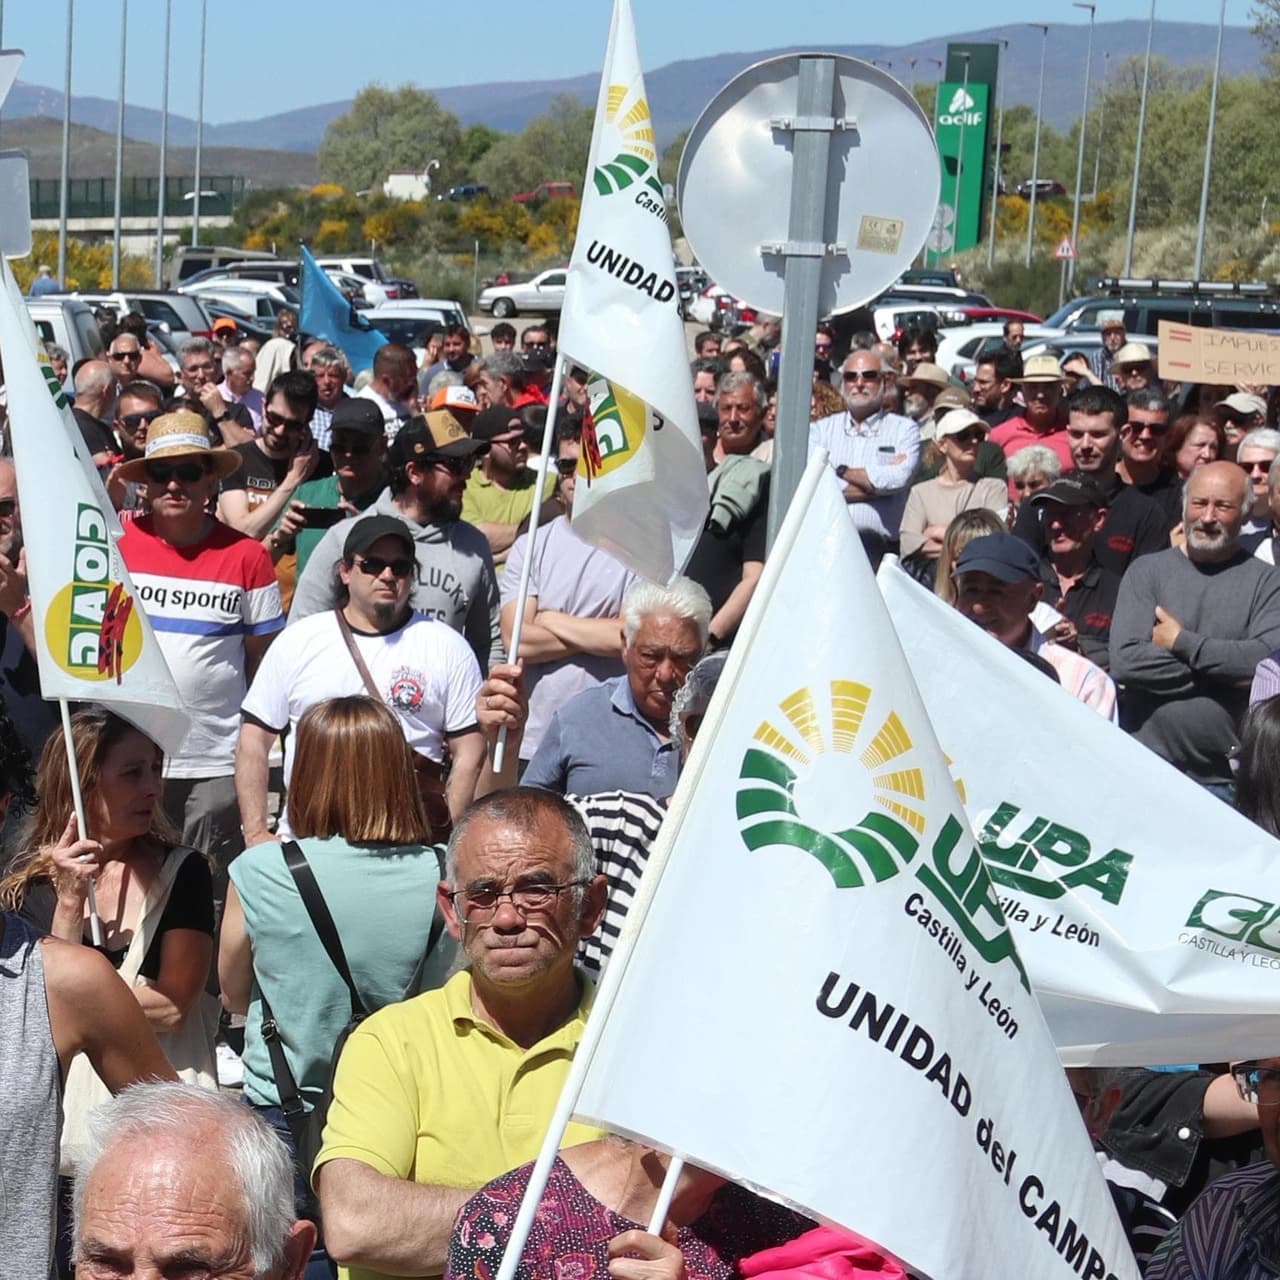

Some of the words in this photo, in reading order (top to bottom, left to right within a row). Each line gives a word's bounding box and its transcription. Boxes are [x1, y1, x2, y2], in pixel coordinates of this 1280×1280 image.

[586, 239, 675, 303] UNIDAD
[171, 586, 242, 614] sportif
[978, 800, 1134, 905] UPA
[1030, 913, 1049, 932] y
[1051, 913, 1100, 948] León
[1178, 931, 1238, 962] CASTILLA
[904, 892, 967, 974] Castilla
[965, 969, 981, 992] y
[978, 981, 1019, 1040] León
[815, 970, 972, 1118] UNIDAD
[976, 1118, 1017, 1186] del
